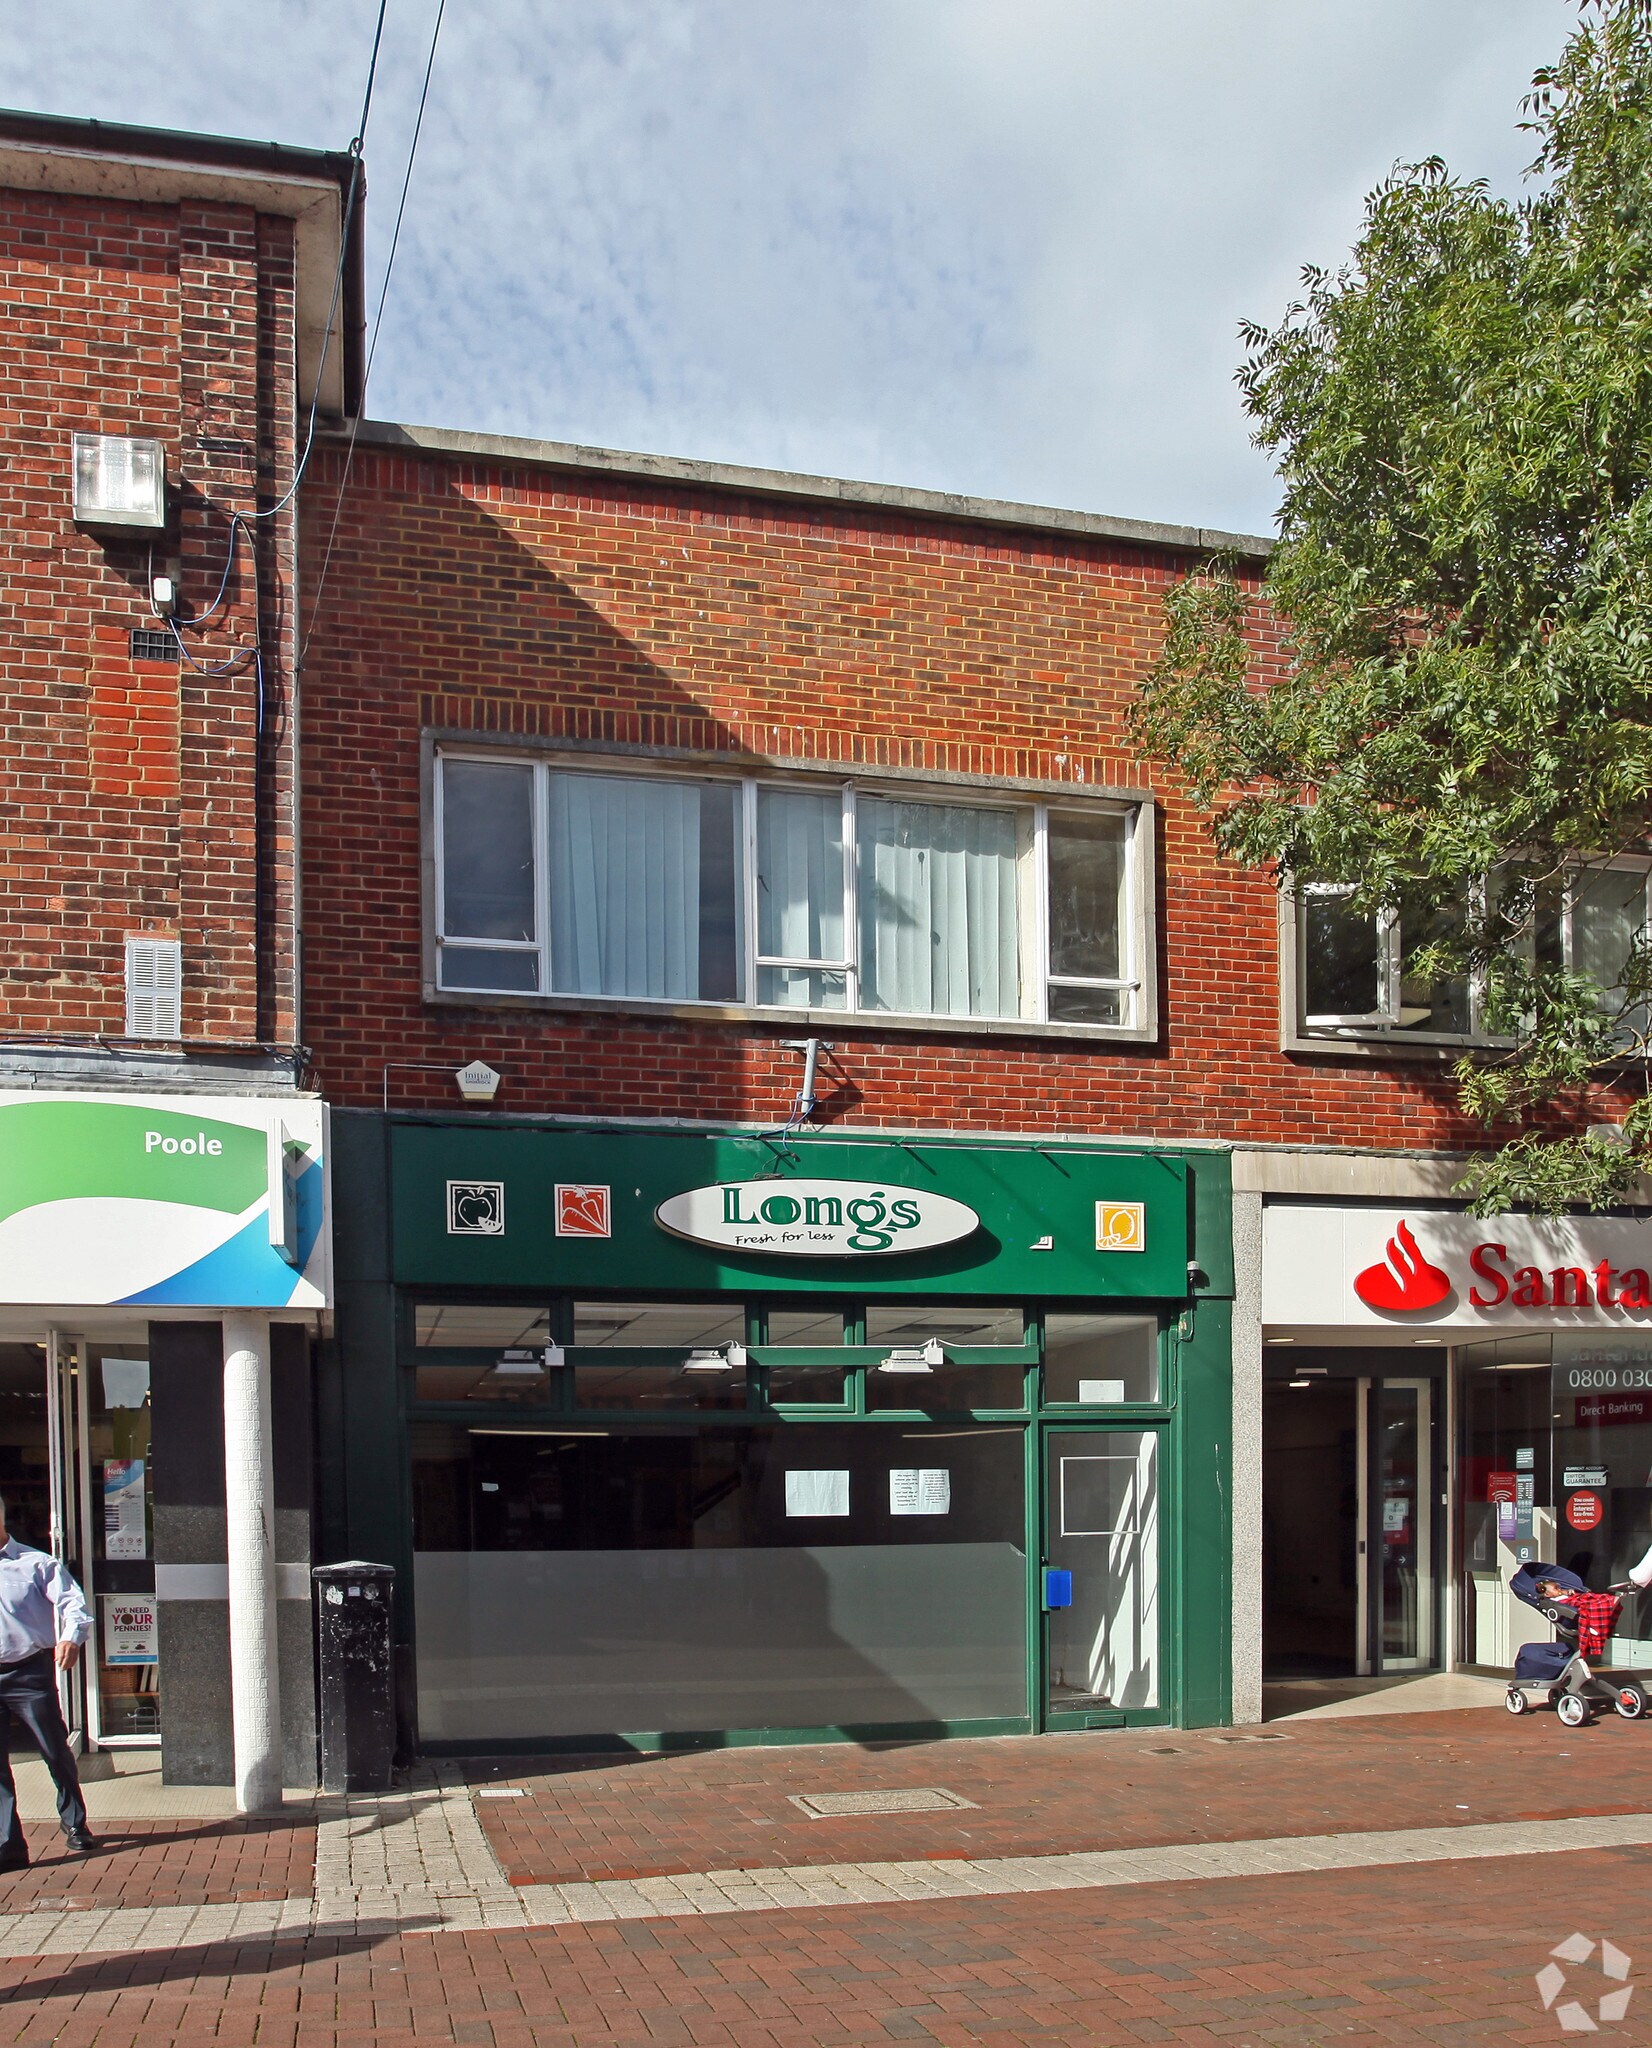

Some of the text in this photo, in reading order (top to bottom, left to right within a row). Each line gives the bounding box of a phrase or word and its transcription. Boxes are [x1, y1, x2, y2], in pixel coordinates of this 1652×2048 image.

[465, 1071, 491, 1080] Initial
[144, 1131, 223, 1156] Poole
[721, 1187, 922, 1251] Longs
[735, 1230, 836, 1246] Fresh for less
[1469, 1243, 1652, 1309] Santa
[1569, 1369, 1652, 1388] 0800 030
[1580, 1402, 1643, 1416] Direct Banking
[111, 1613, 153, 1625] YOUR
